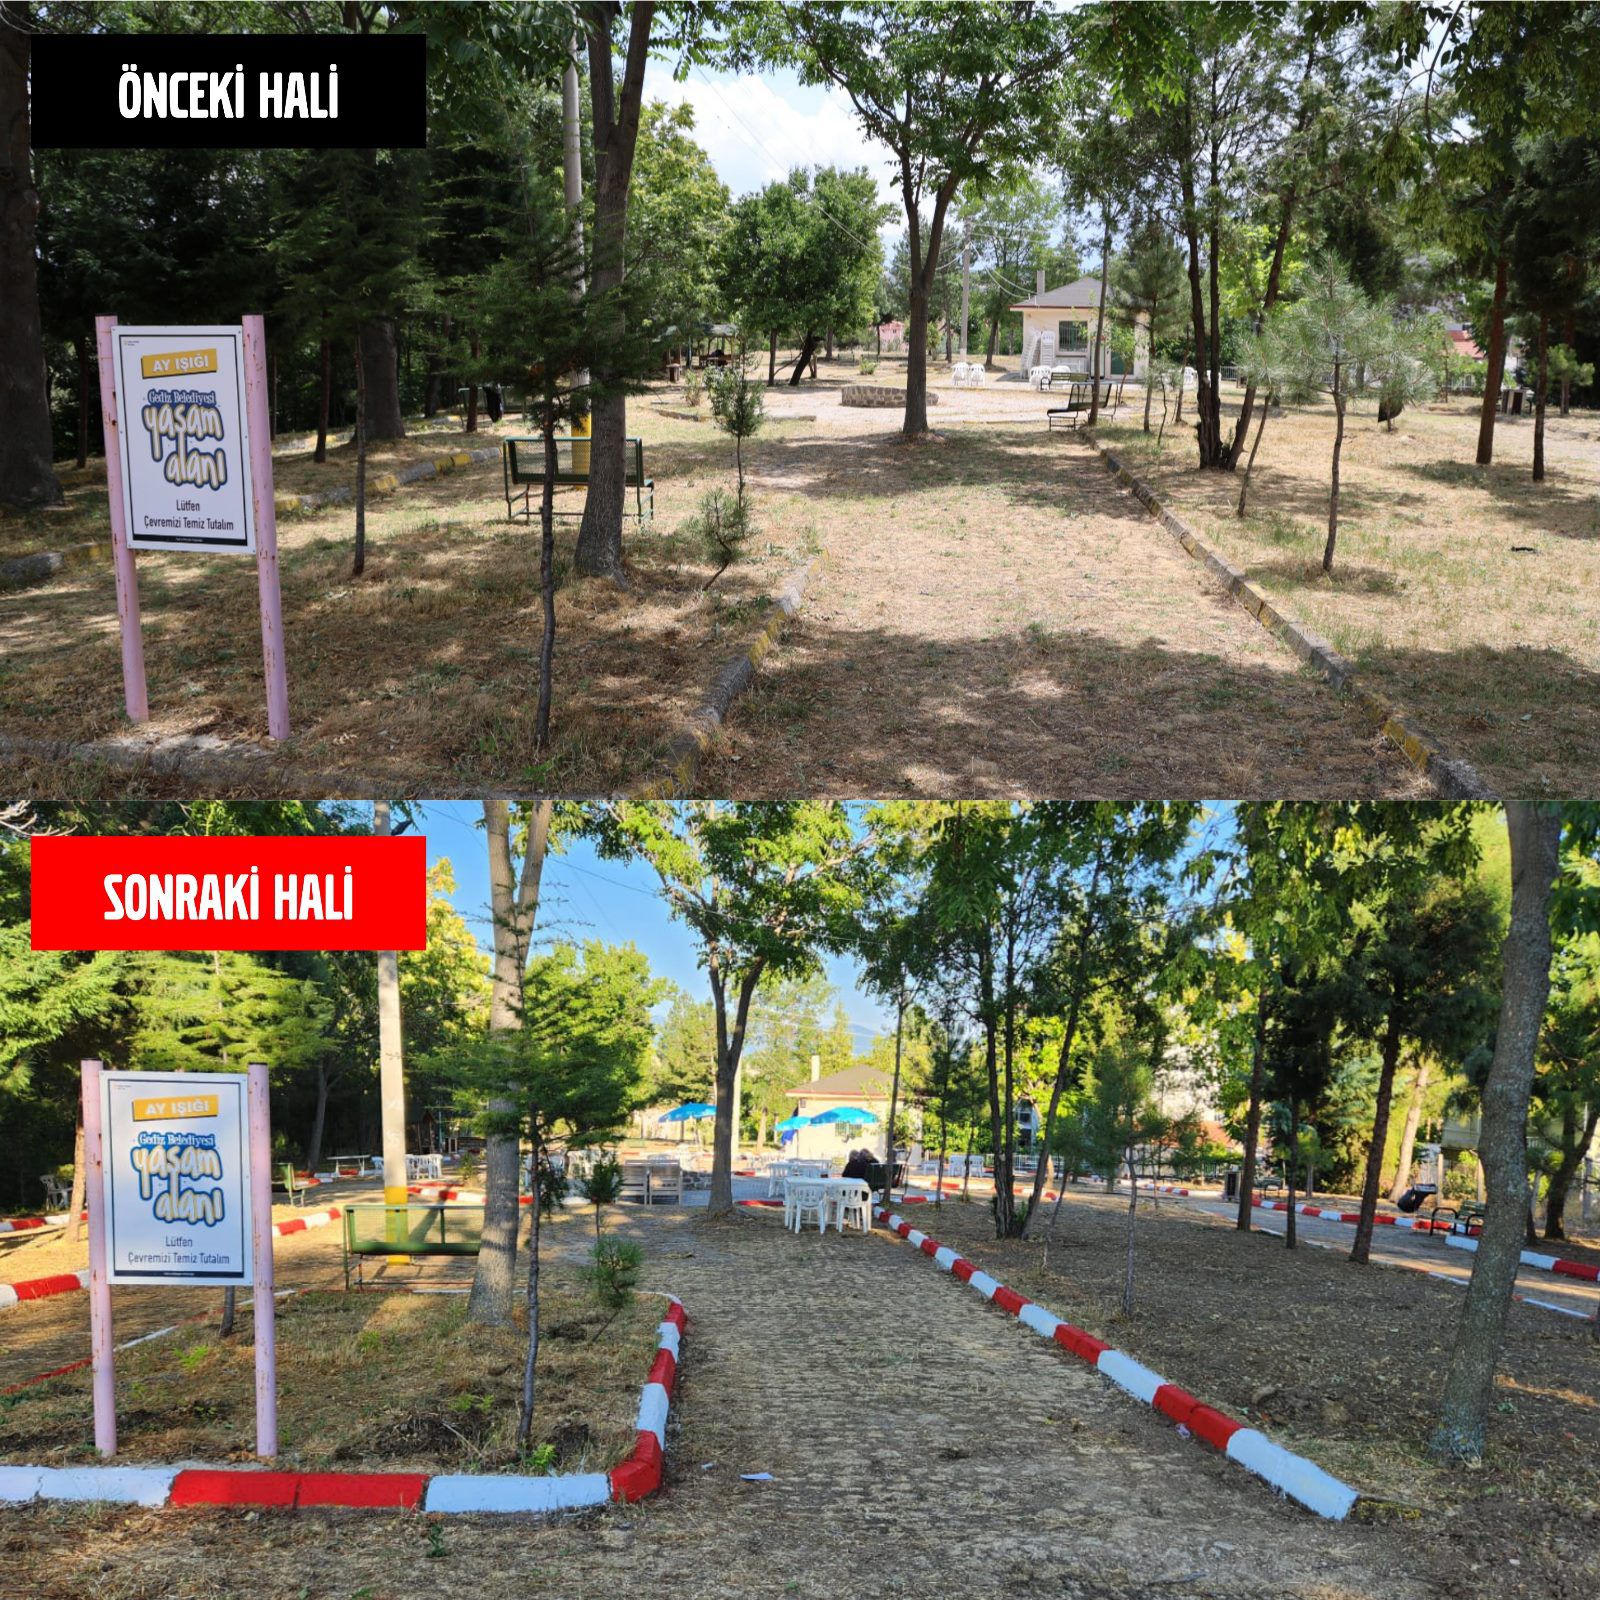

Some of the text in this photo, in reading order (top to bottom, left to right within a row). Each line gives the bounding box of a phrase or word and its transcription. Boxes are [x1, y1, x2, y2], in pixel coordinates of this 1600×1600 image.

[152, 353, 209, 373] AY IŞIĞI
[147, 389, 216, 405] Gediz Belediyesi
[142, 403, 224, 462] yaşam
[164, 446, 227, 491] alanı
[176, 499, 201, 512] Lütfen
[143, 515, 234, 531] Çevremizi Temiz Tutalım
[145, 1098, 209, 1116] AY IŞIĞI
[131, 1145, 223, 1201] yaşam
[153, 1186, 225, 1227] alanı
[165, 1236, 193, 1248] Lütfen
[127, 1251, 230, 1265] Çevremizi Temiz Tutalım
